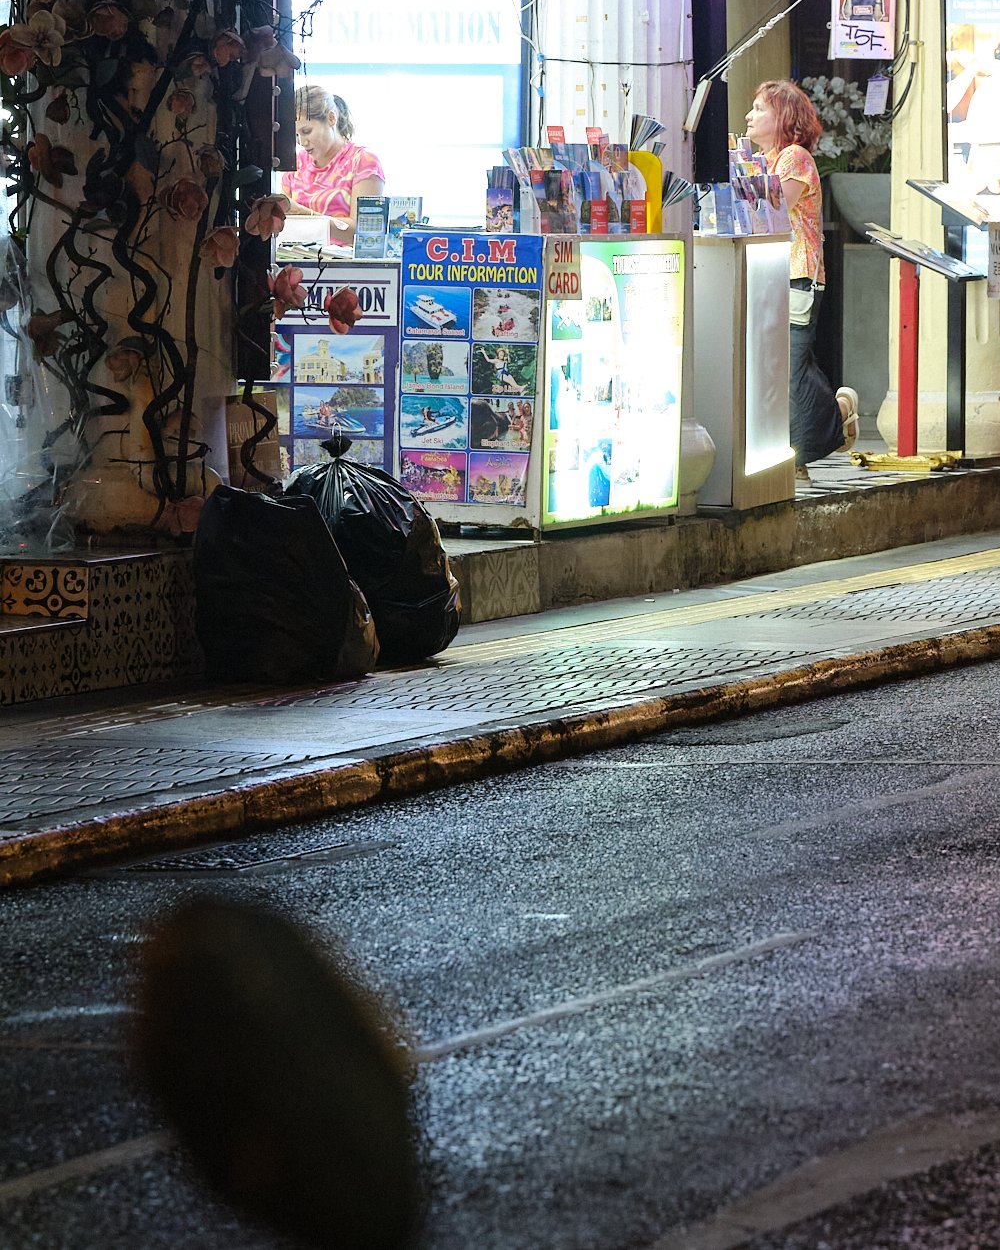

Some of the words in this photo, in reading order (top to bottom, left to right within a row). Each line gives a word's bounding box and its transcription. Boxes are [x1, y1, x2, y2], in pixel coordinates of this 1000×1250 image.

[426, 236, 517, 264] C.I.M
[554, 240, 574, 264] SIM
[408, 263, 444, 281] TOUR
[447, 264, 537, 284] INFORMATION
[548, 272, 579, 296] CARD
